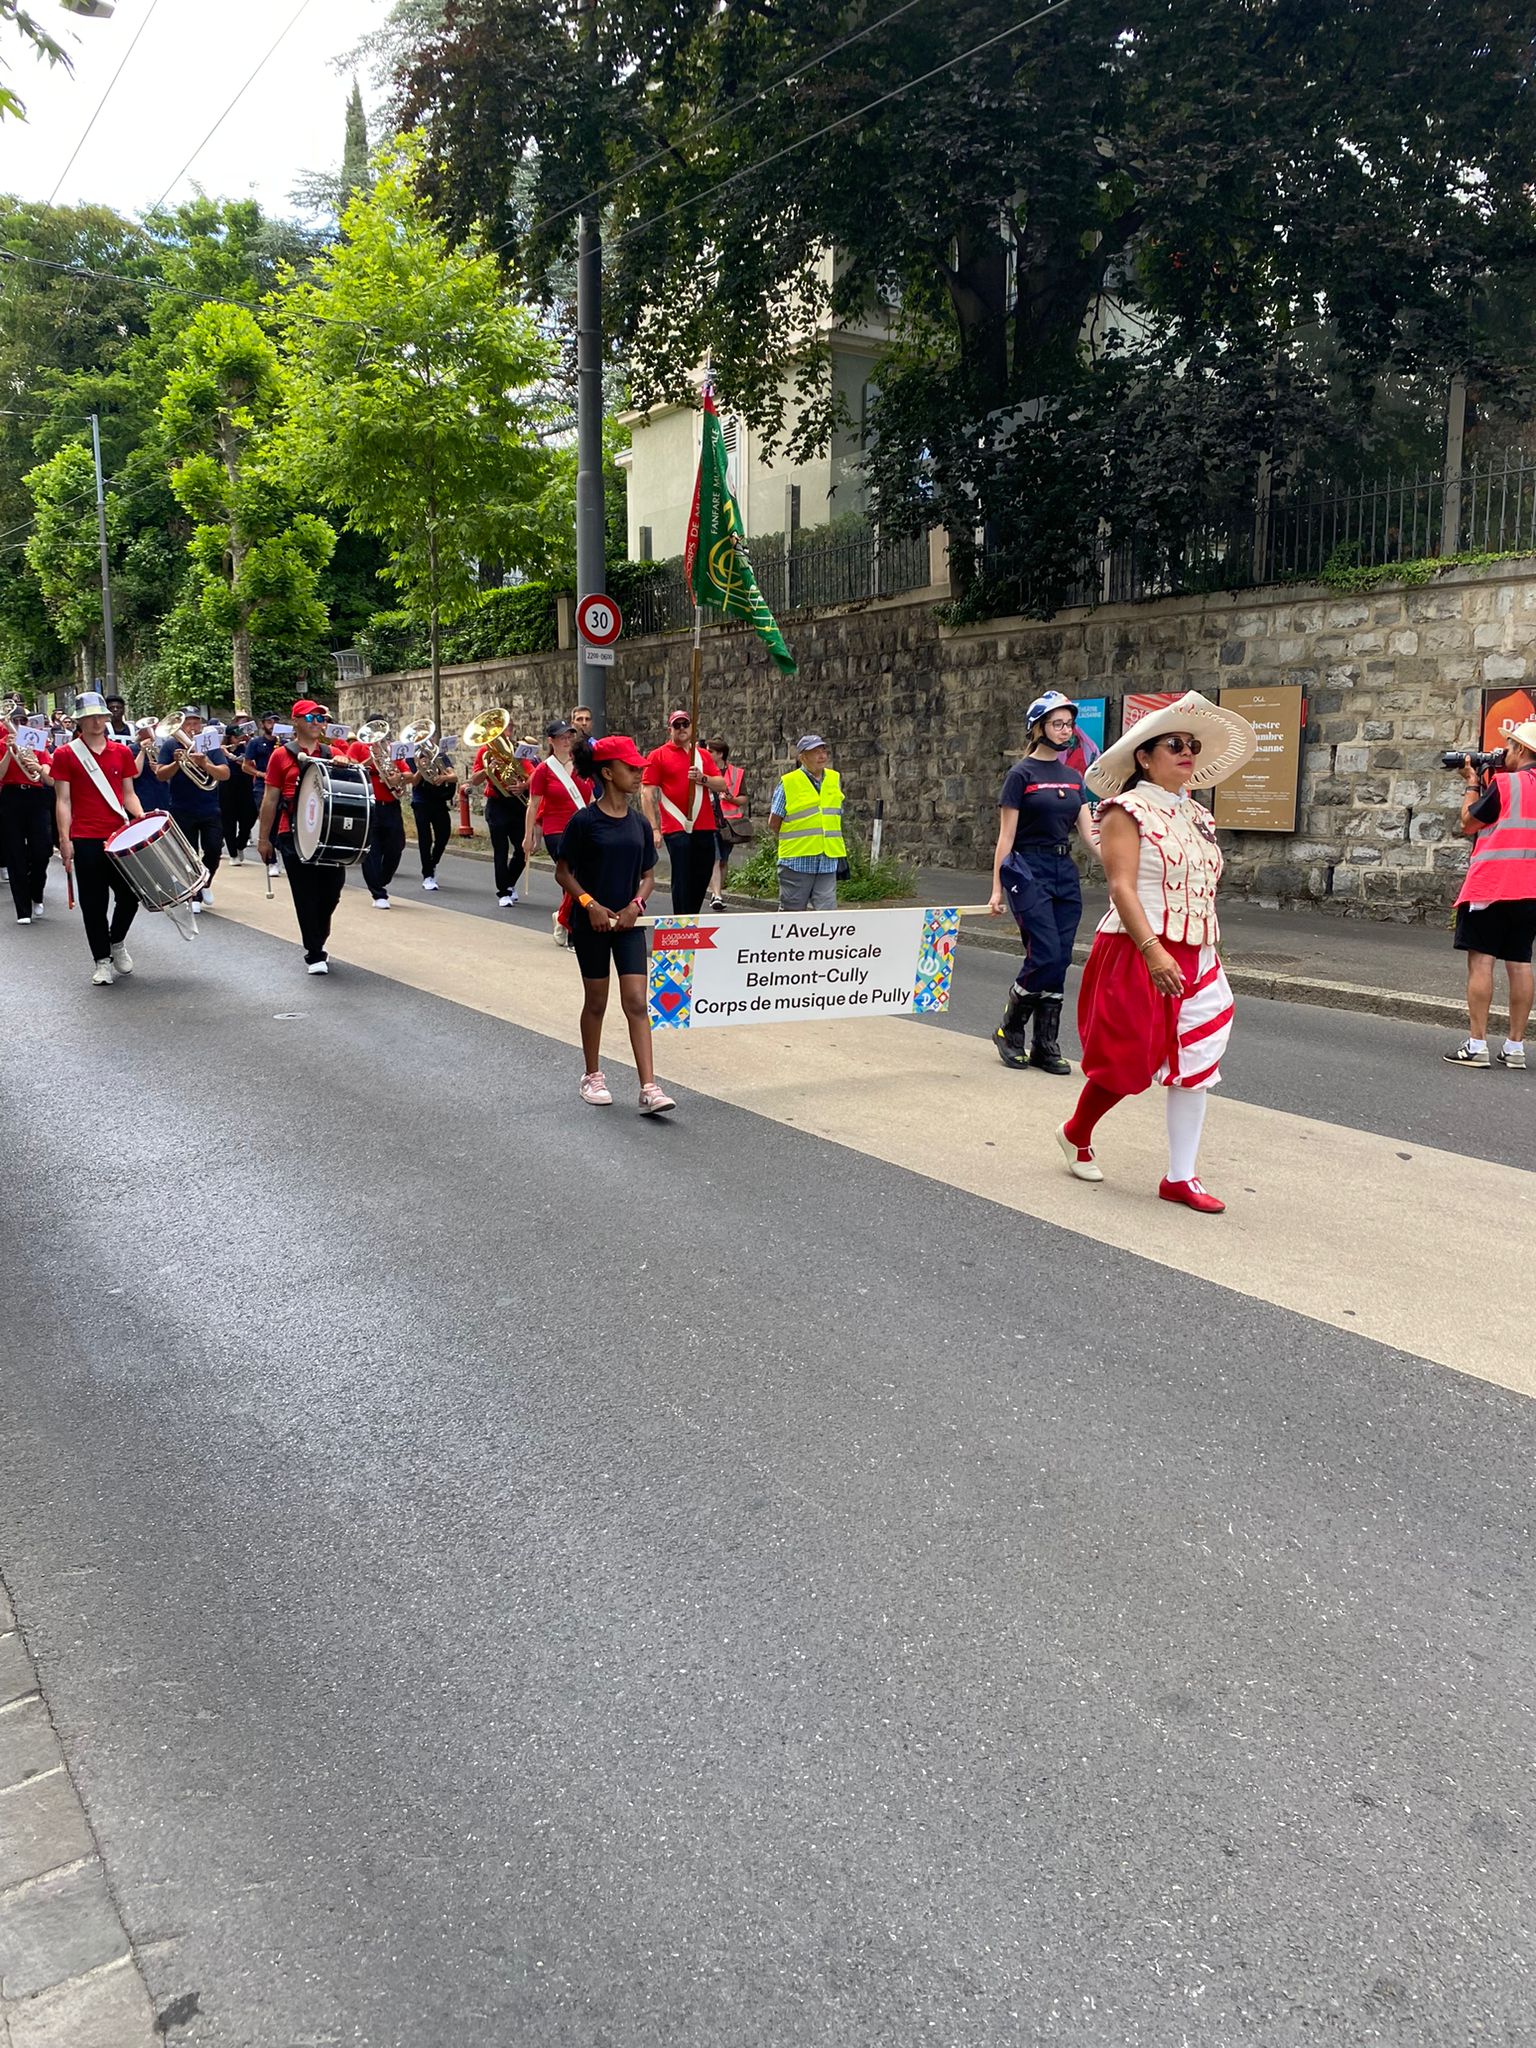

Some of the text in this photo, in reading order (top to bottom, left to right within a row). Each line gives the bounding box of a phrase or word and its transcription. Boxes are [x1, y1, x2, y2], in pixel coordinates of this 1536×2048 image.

[710, 492, 721, 535] FANFARE
[690, 521, 700, 537] DE
[591, 610, 609, 630] 30
[1251, 720, 1281, 729] hestre
[771, 922, 856, 941] L'AveLyre
[737, 944, 882, 964] Entente musicale
[746, 967, 869, 988] Belmont-Cully
[694, 987, 911, 1017] Corps de musique de Pully
